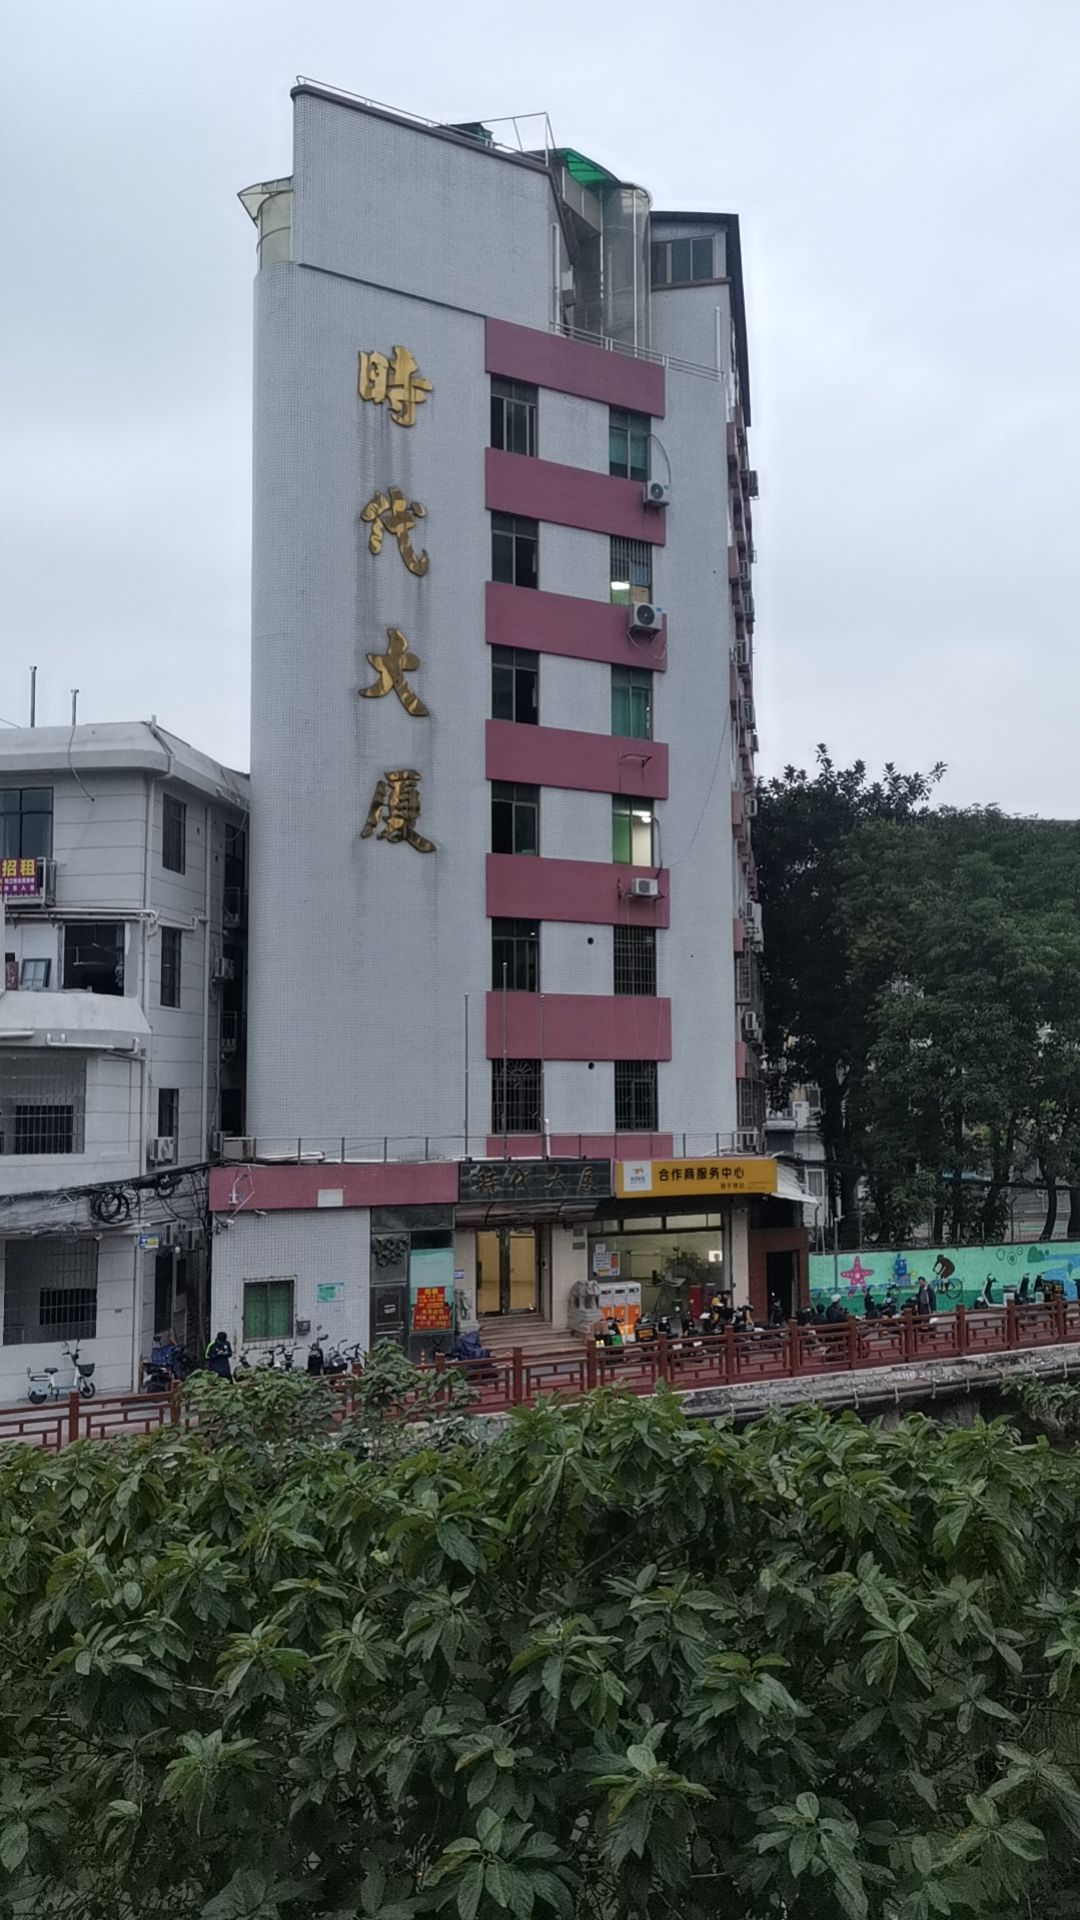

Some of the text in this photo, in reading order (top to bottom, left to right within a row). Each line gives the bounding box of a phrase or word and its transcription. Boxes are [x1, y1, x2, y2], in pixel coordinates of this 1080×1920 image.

[658, 1166, 745, 1182] 合作商服务中心
